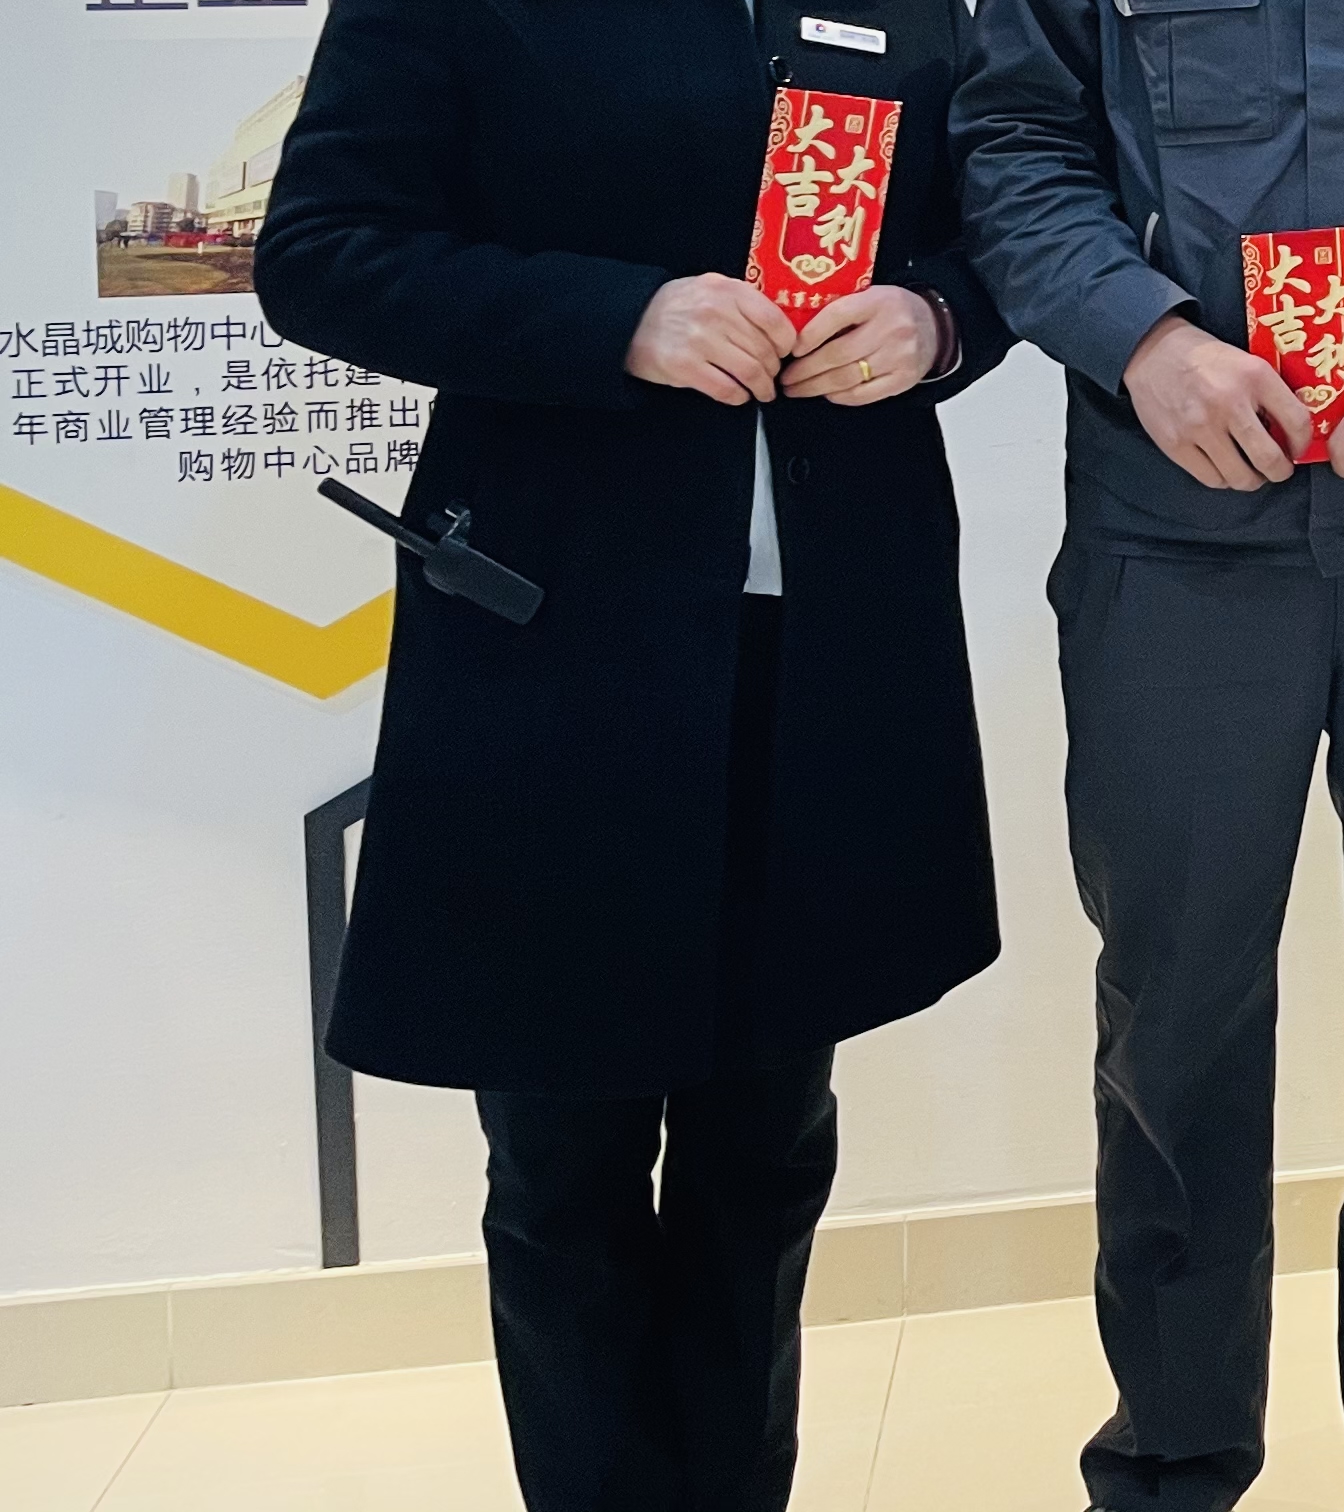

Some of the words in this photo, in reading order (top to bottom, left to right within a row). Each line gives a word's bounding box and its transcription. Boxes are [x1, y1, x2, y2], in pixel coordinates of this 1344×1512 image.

[0, 314, 286, 359] 水晶城购物中心
[13, 395, 435, 446] 年商业管理经验而推出
[177, 438, 420, 483] 购物中心品牌
